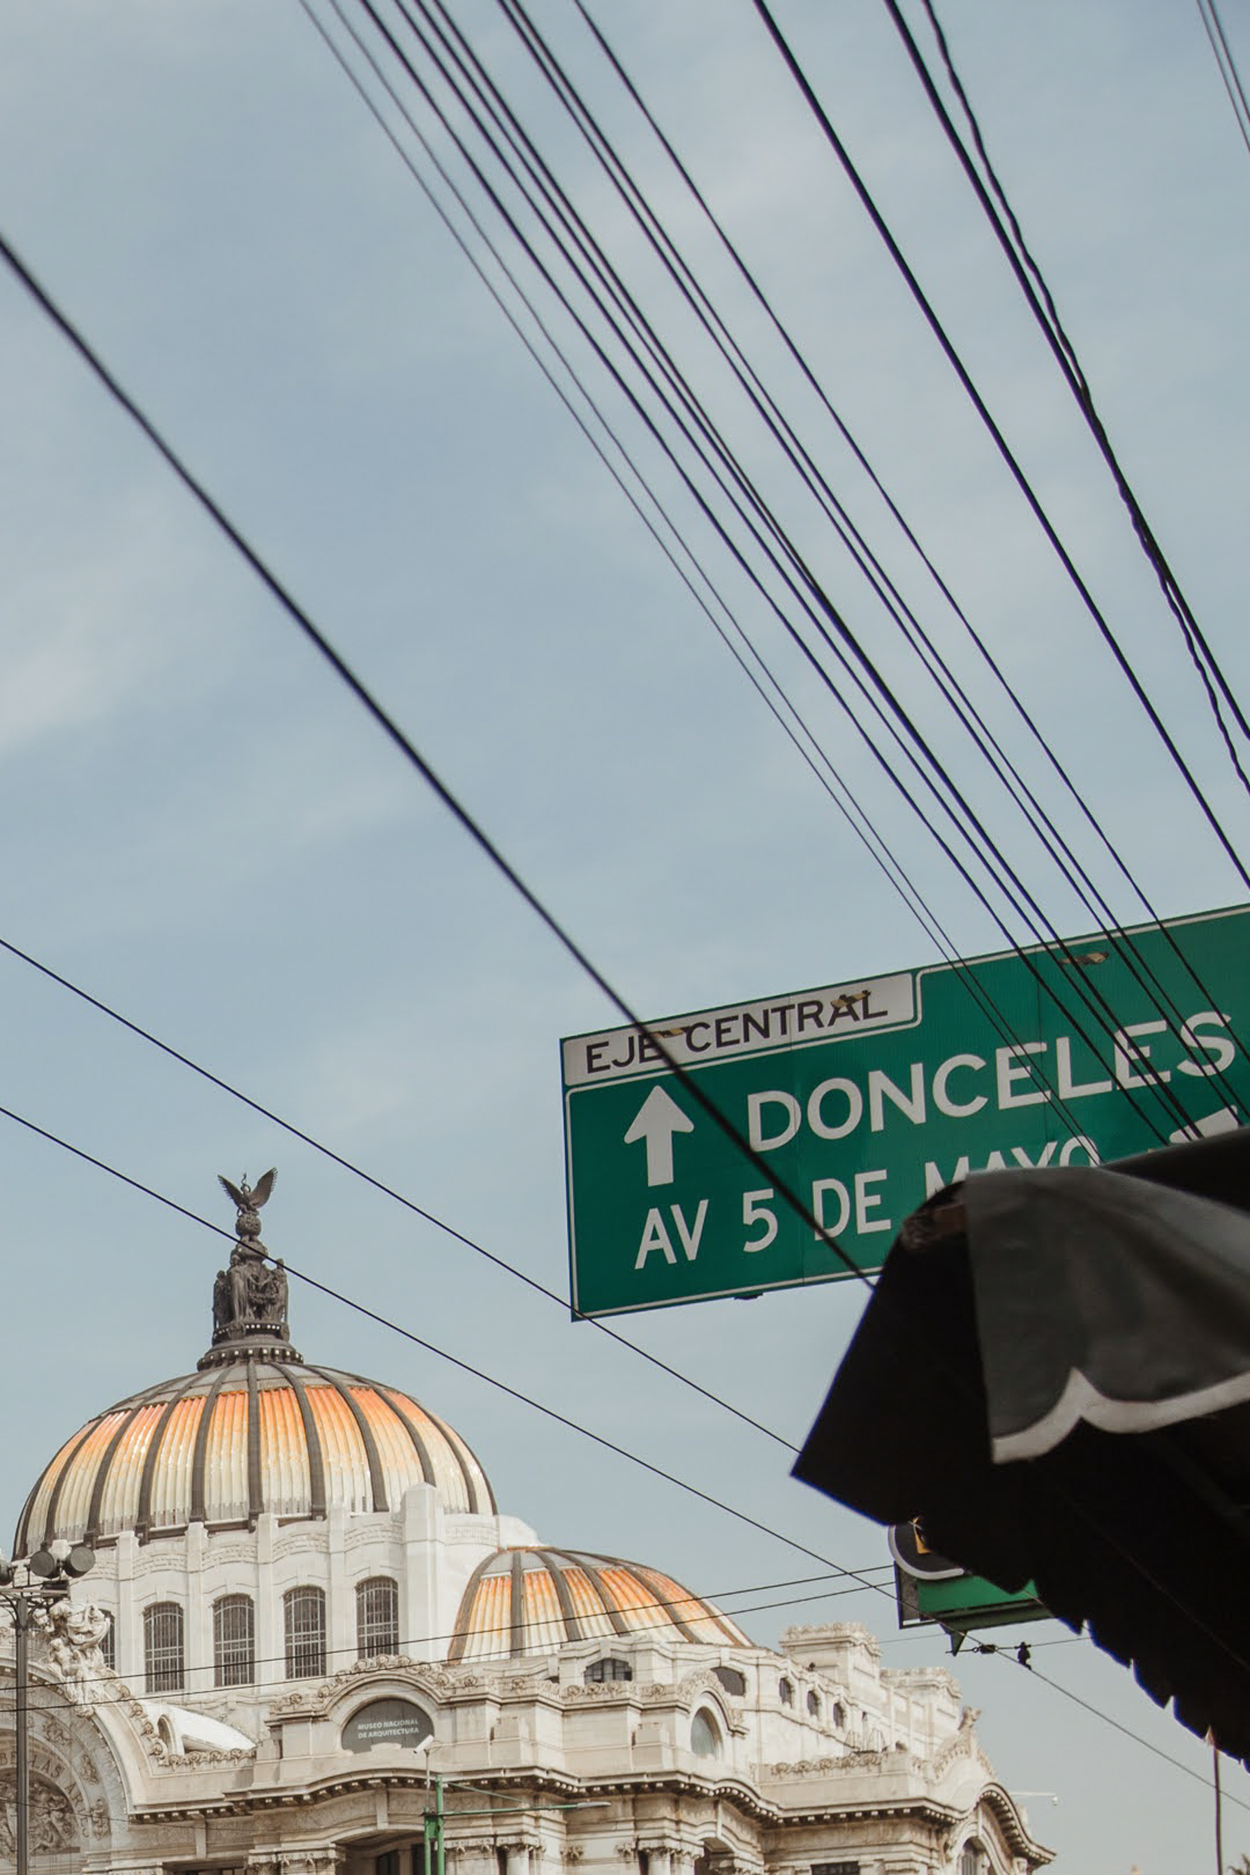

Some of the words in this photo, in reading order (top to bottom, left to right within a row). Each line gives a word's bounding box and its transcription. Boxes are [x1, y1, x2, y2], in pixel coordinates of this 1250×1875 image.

[586, 1031, 665, 1075] EJE
[686, 991, 889, 1052] CENTRAL
[747, 1010, 1236, 1153] DONCELES
[634, 1199, 709, 1270] AV
[742, 1188, 779, 1253] 5
[812, 1169, 892, 1241] DE
[357, 1721, 383, 1731] MUSEO
[383, 1718, 419, 1728] NACIONAL
[357, 1731, 368, 1739] DE
[368, 1727, 420, 1738] ARQUITECTURA
[0, 1751, 66, 1778] BELAS
